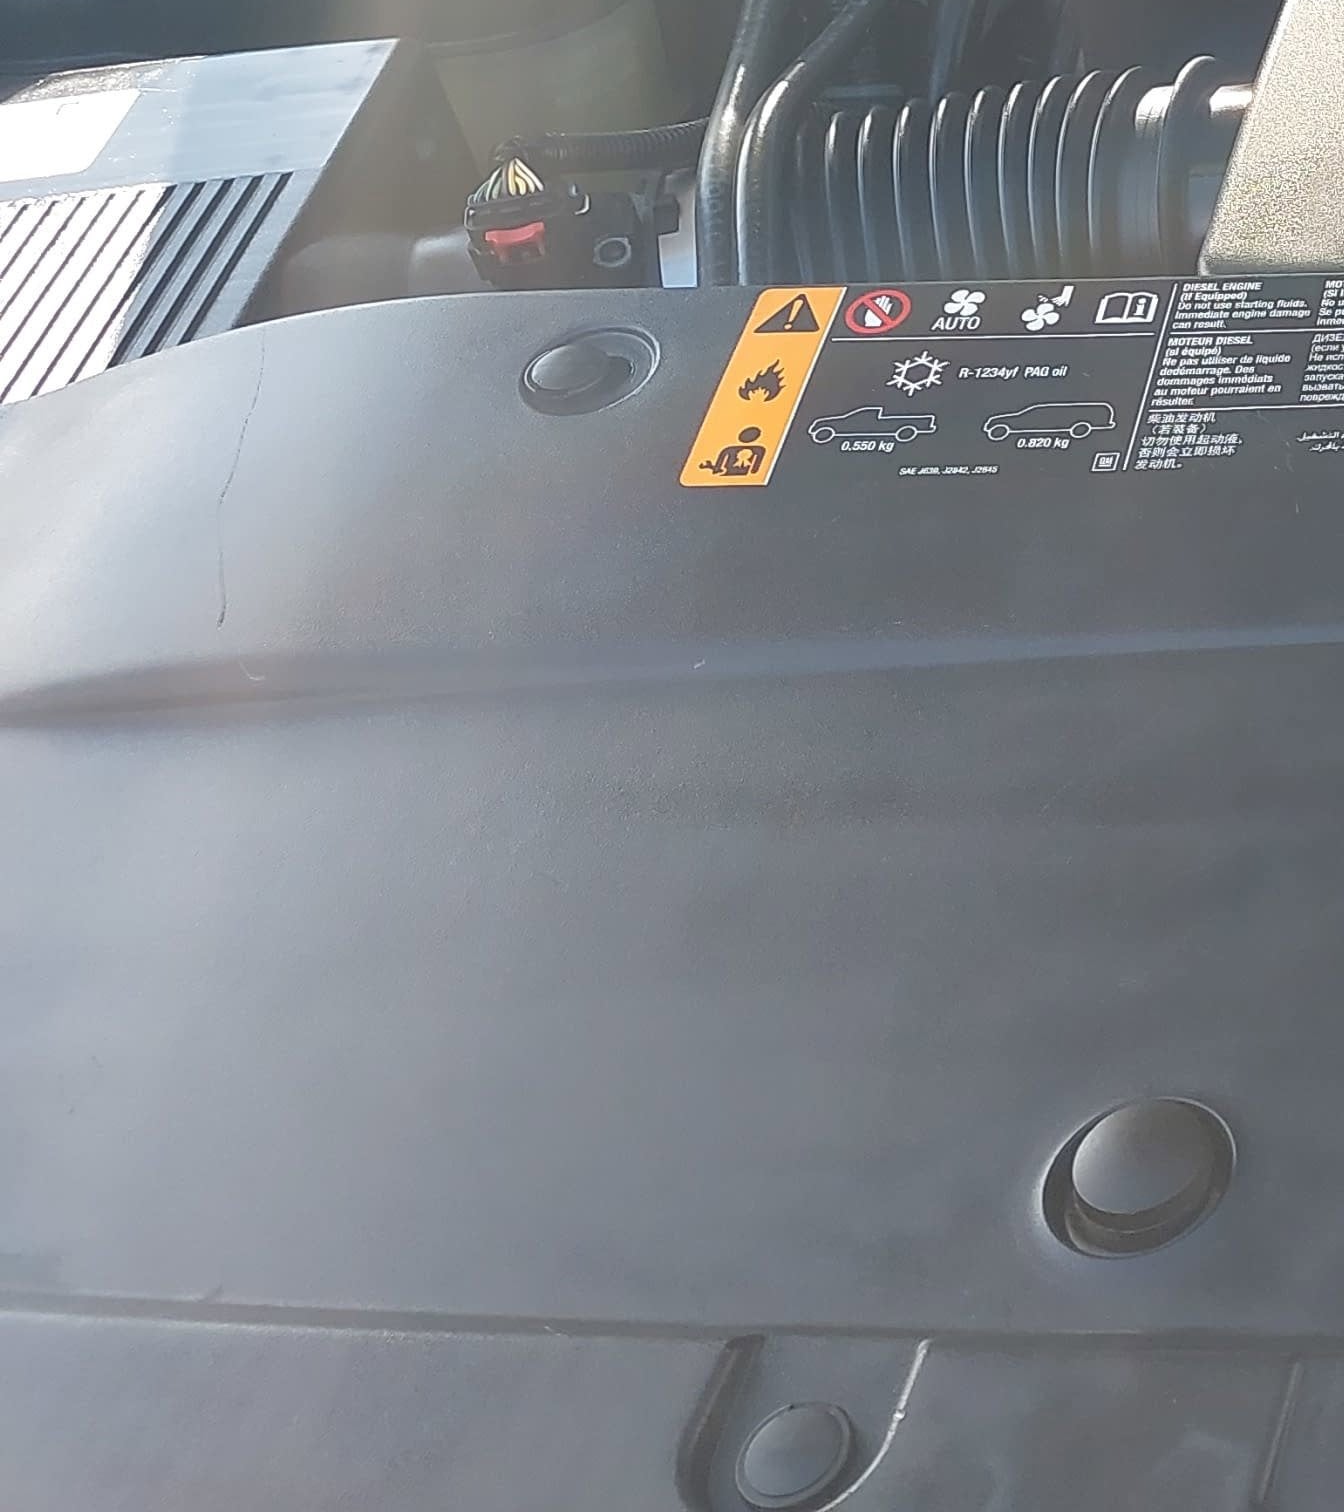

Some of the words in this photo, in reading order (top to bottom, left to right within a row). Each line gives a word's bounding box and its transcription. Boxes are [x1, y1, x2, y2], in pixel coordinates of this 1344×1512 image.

[1182, 282, 1220, 291] DIESEL
[1222, 282, 1263, 291] ENGINE
[1194, 292, 1248, 301] Equipped)
[1177, 302, 1192, 310] Do
[1194, 302, 1212, 310] not
[1214, 301, 1232, 309] use
[1234, 300, 1275, 309] starting
[1276, 299, 1308, 308] fluids.
[1320, 298, 1336, 307] No
[1174, 311, 1230, 320] Immediate
[1231, 310, 1267, 320] engine
[1269, 309, 1311, 318] damage
[1318, 307, 1333, 316] Se
[931, 316, 981, 331] AUTO
[1172, 321, 1191, 329] can
[1193, 320, 1227, 329] result.
[1167, 337, 1213, 347] MOTEUR
[1216, 335, 1253, 345] DIESEL
[1162, 357, 1177, 366] Ne
[1179, 358, 1198, 367] pas
[1201, 356, 1237, 365] utiliser
[1240, 355, 1253, 363] de
[1255, 354, 1291, 364] liquide
[1308, 353, 1324, 362] Не
[958, 366, 1020, 379] R-1234yf
[1024, 366, 1048, 378] PAG
[1051, 366, 1068, 377] oil
[1234, 365, 1255, 374] Des
[1156, 376, 1216, 386] dommages
[1153, 388, 1168, 396] au
[1170, 387, 1209, 395] moteur
[1210, 384, 1265, 396] pourraient
[1267, 385, 1282, 393] en
[1147, 412, 1216, 424] 柴油发动机
[840, 441, 876, 451] 0.550
[878, 441, 895, 453] kg
[1016, 437, 1052, 448] 0.820
[1053, 437, 1070, 449] kg
